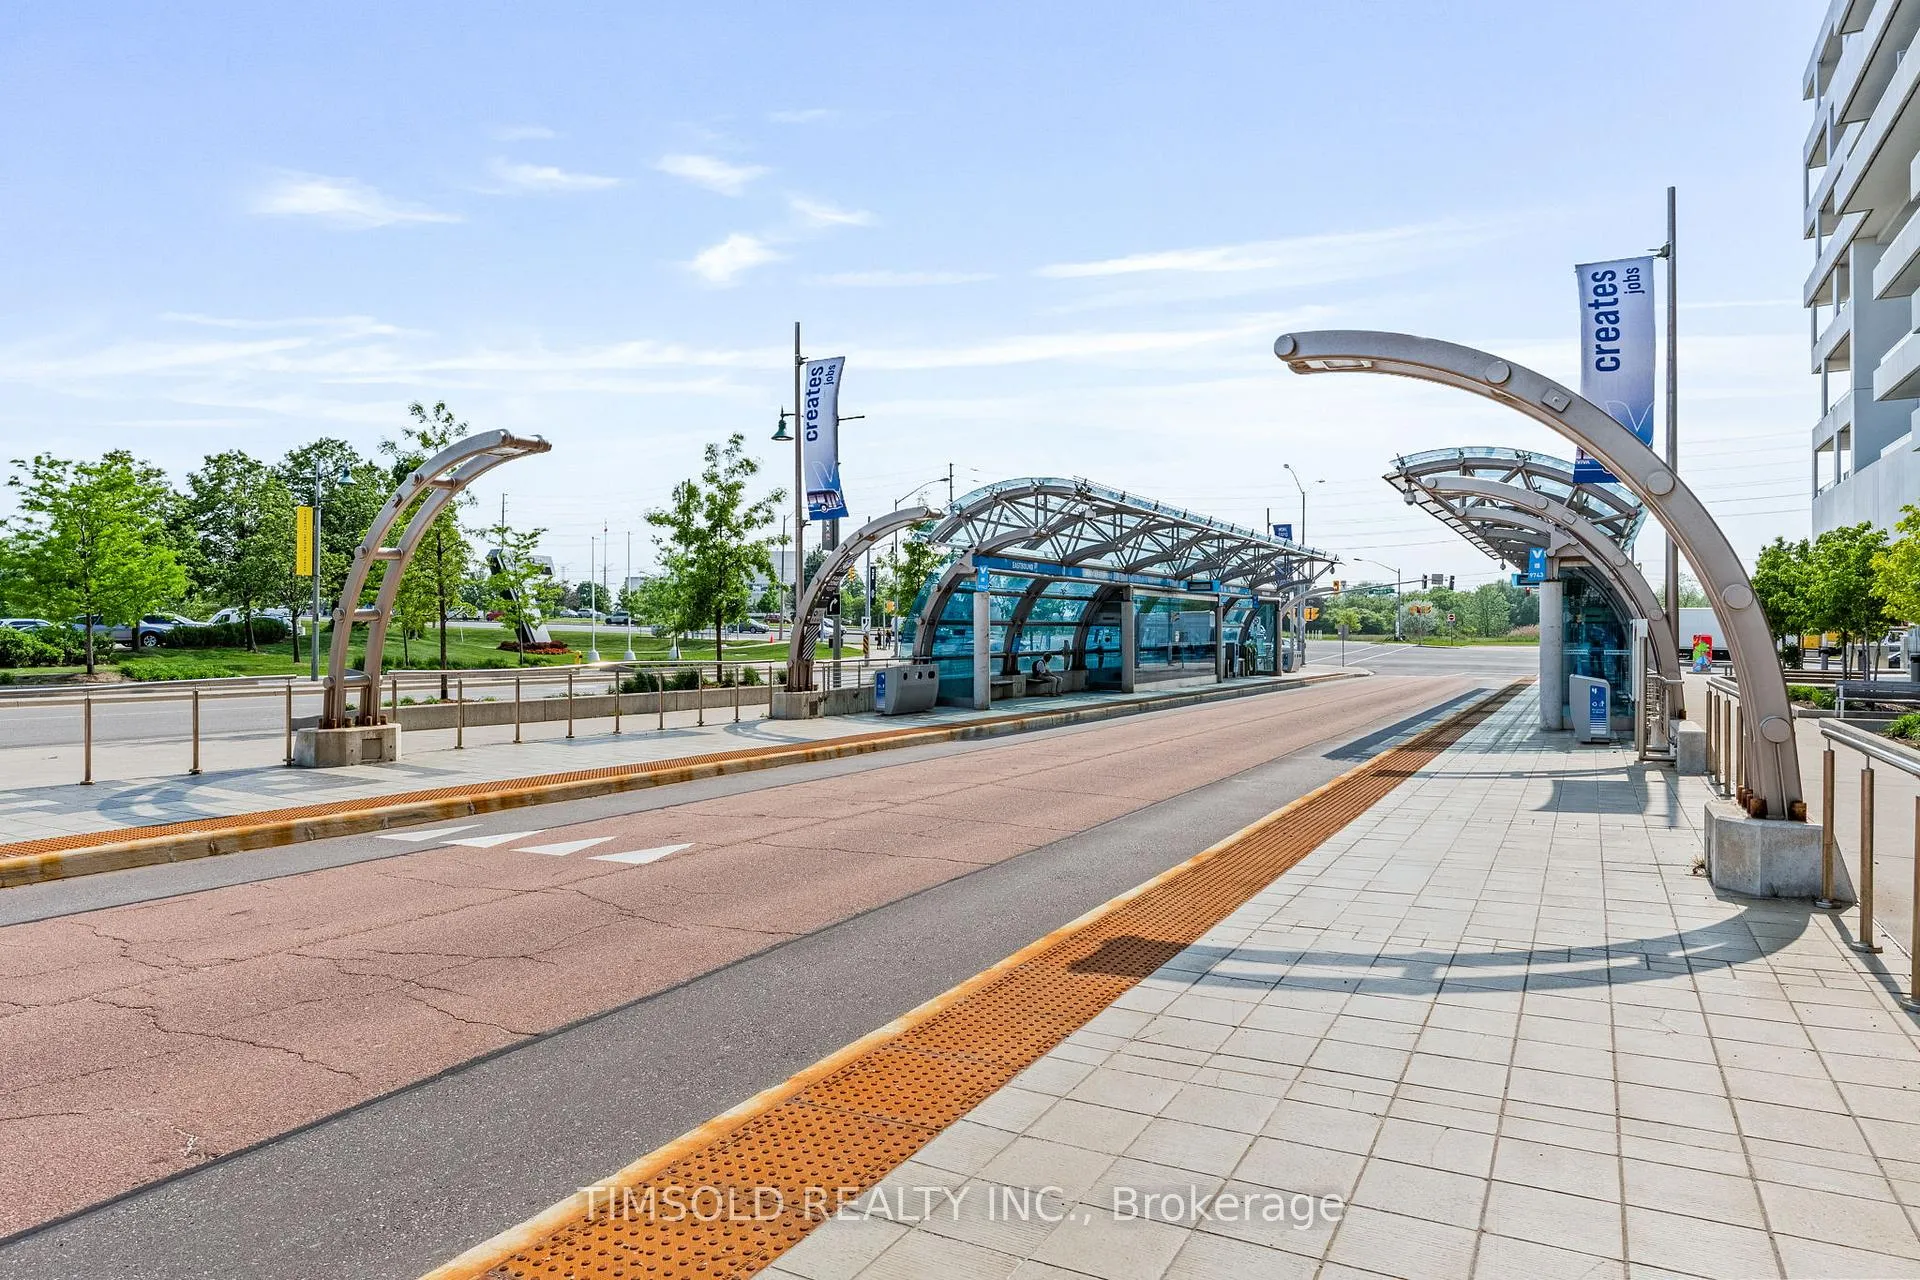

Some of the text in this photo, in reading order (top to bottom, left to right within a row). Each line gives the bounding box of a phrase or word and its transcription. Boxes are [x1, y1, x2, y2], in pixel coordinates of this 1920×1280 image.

[1623, 267, 1645, 294] jobs
[1588, 269, 1620, 371] creates
[824, 364, 836, 385] jobs
[806, 366, 824, 441] creates
[1012, 561, 1033, 571] EASTBOUND
